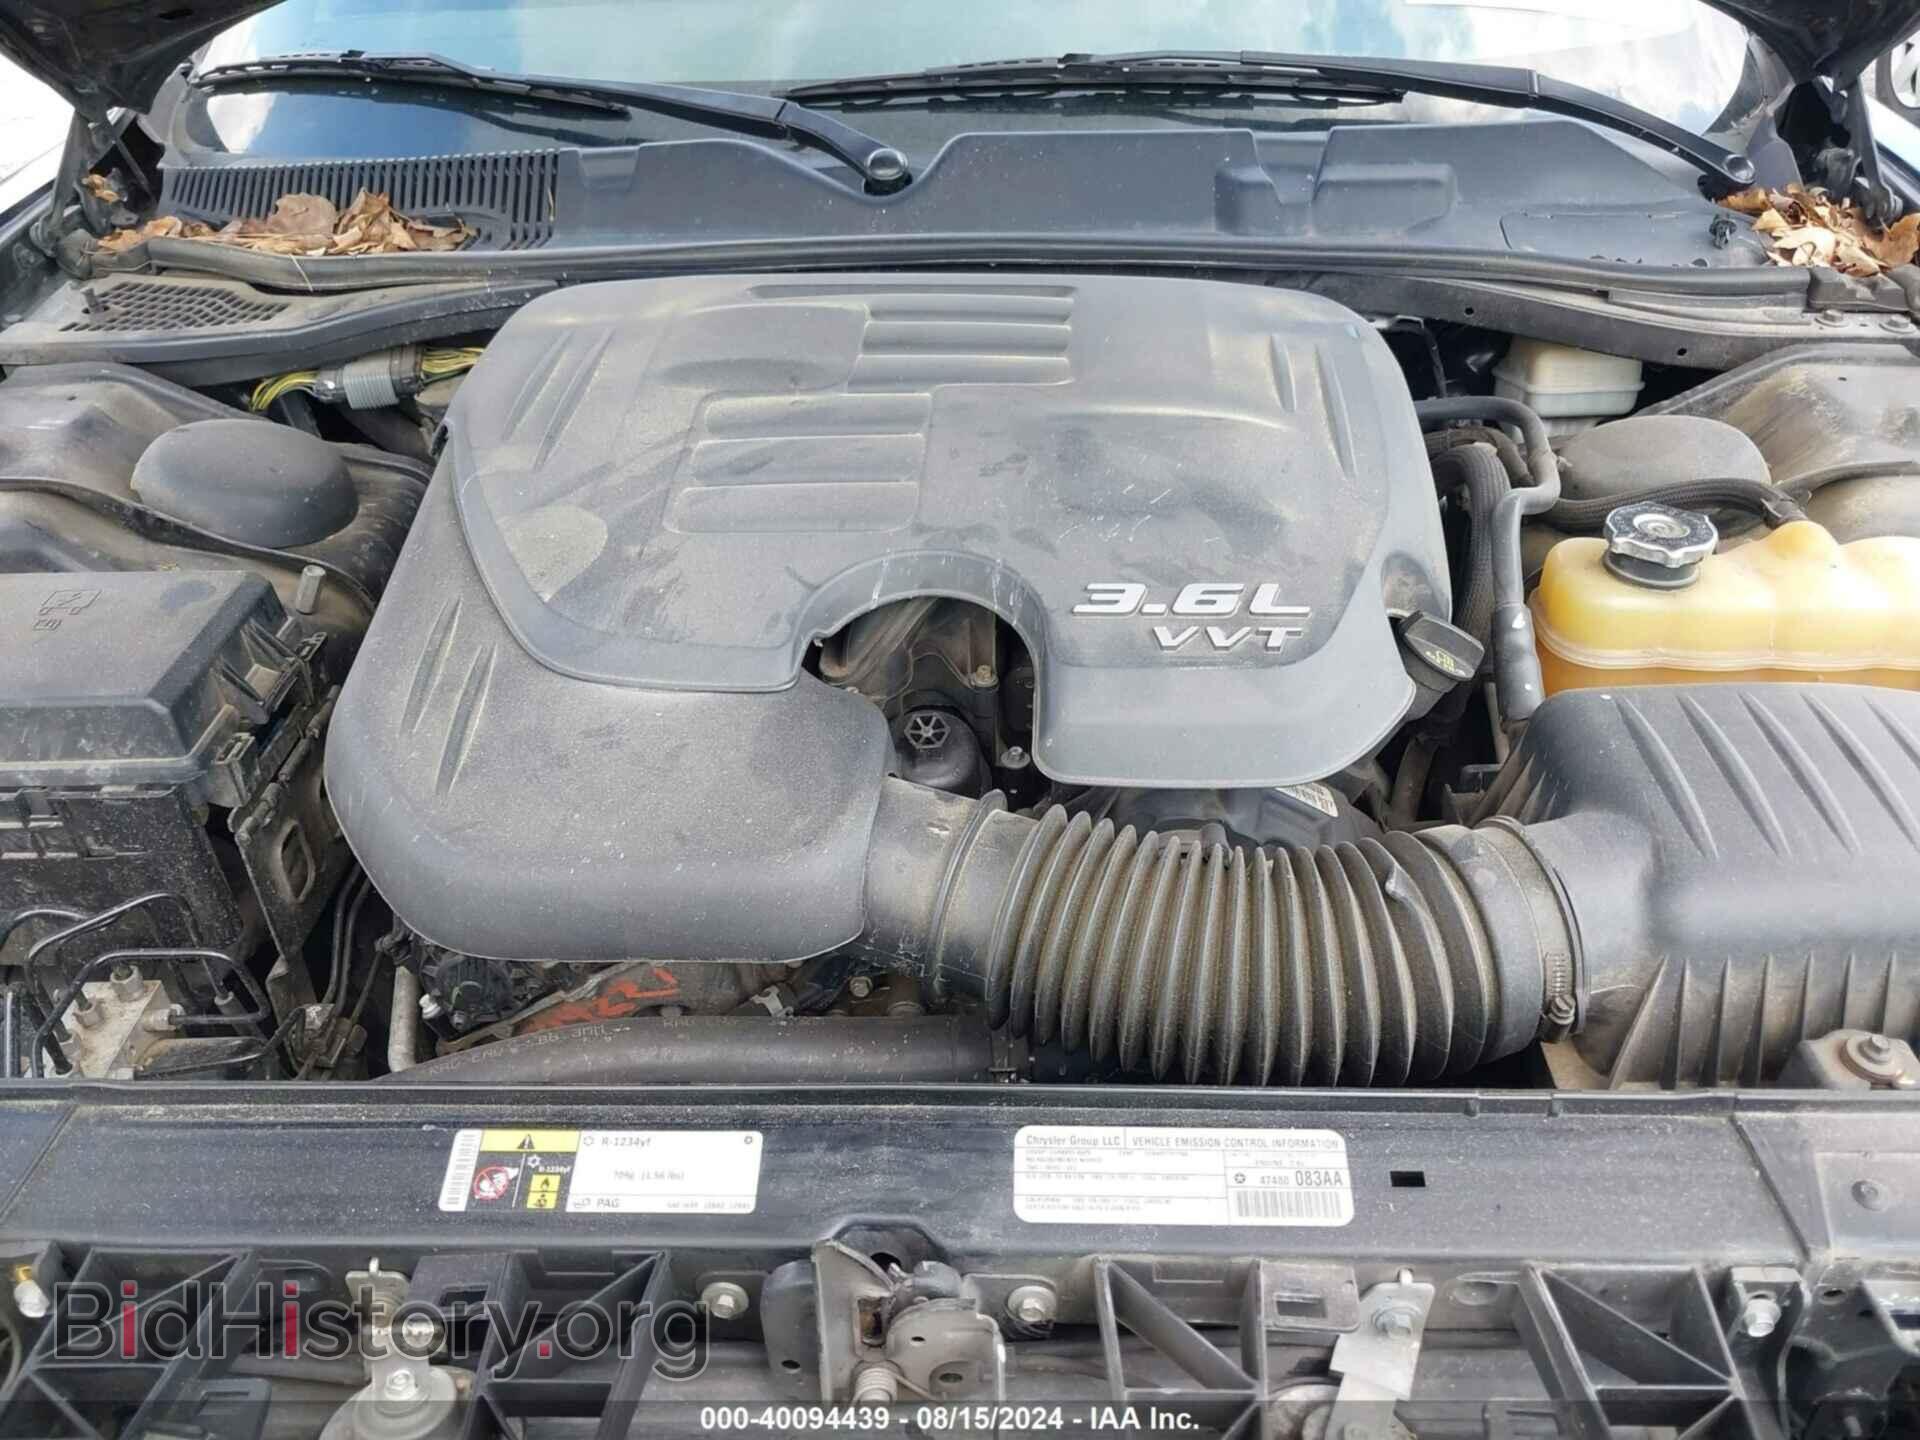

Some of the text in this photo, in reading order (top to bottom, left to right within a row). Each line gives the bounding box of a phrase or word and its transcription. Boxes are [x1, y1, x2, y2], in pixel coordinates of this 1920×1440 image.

[1072, 583, 1311, 614] 3.6L
[1152, 626, 1304, 651] VVT
[1025, 1134, 1120, 1147] Chrysler Group LLC
[1132, 1136, 1339, 1149] VEHICLE EMISSION CONTROL INFORMATION
[1295, 1170, 1343, 1186] 083AA
[596, 1198, 620, 1209] PAG
